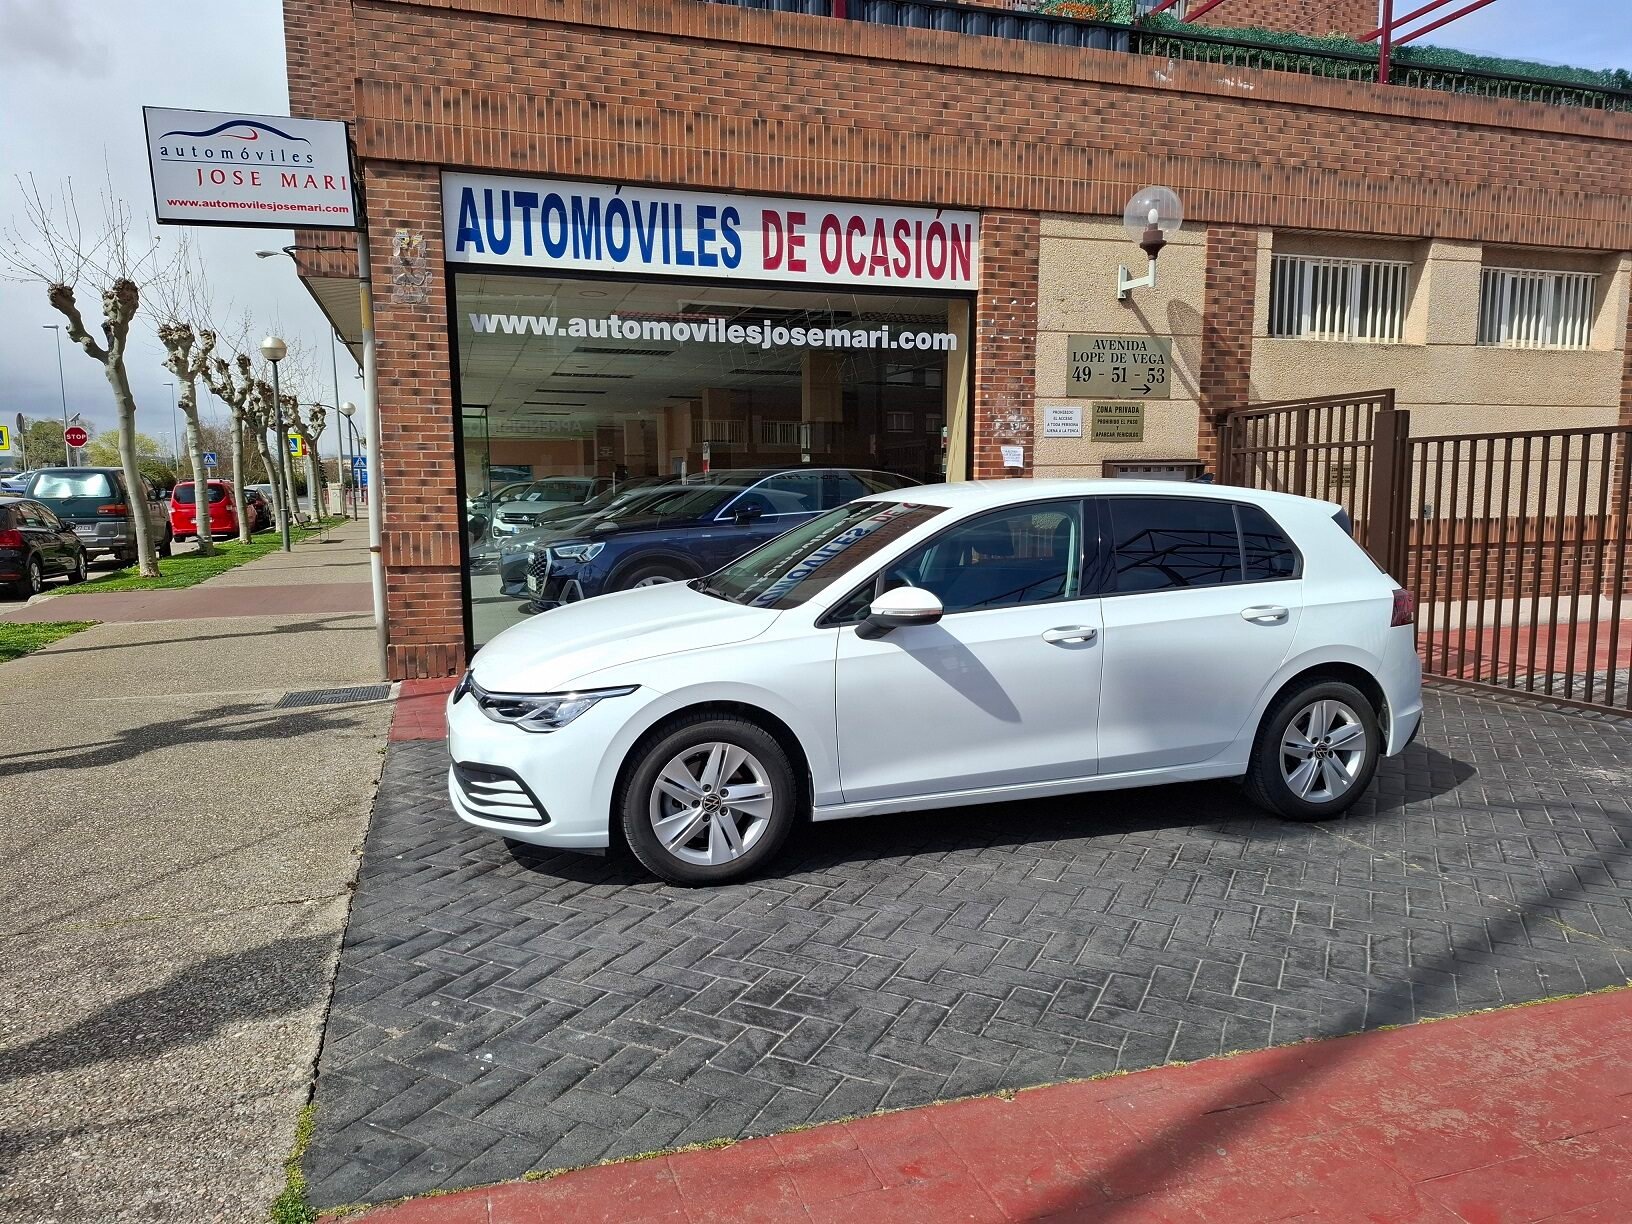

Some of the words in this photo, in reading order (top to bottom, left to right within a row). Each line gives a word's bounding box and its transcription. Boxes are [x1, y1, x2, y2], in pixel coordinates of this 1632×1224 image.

[160, 146, 313, 163] automóviles
[197, 168, 262, 186] JOSE
[281, 172, 348, 191] MARI
[167, 198, 349, 214] www.automovilesjosemari.com
[455, 185, 742, 270] AUTOMÓVILES
[761, 209, 807, 272] DE
[819, 208, 972, 281] OCASIÓN
[468, 313, 958, 351] www.automovilesjosemari.com
[1092, 339, 1147, 351] AVENIDA
[1072, 352, 1105, 362] LOPE
[1110, 353, 1127, 363] DE
[1132, 353, 1165, 364] VEGA
[1072, 366, 1092, 382] 49
[1111, 367, 1128, 383] 51
[1146, 367, 1165, 384] 53
[1096, 405, 1113, 413] ZONA
[1114, 406, 1140, 414] PRIVADA
